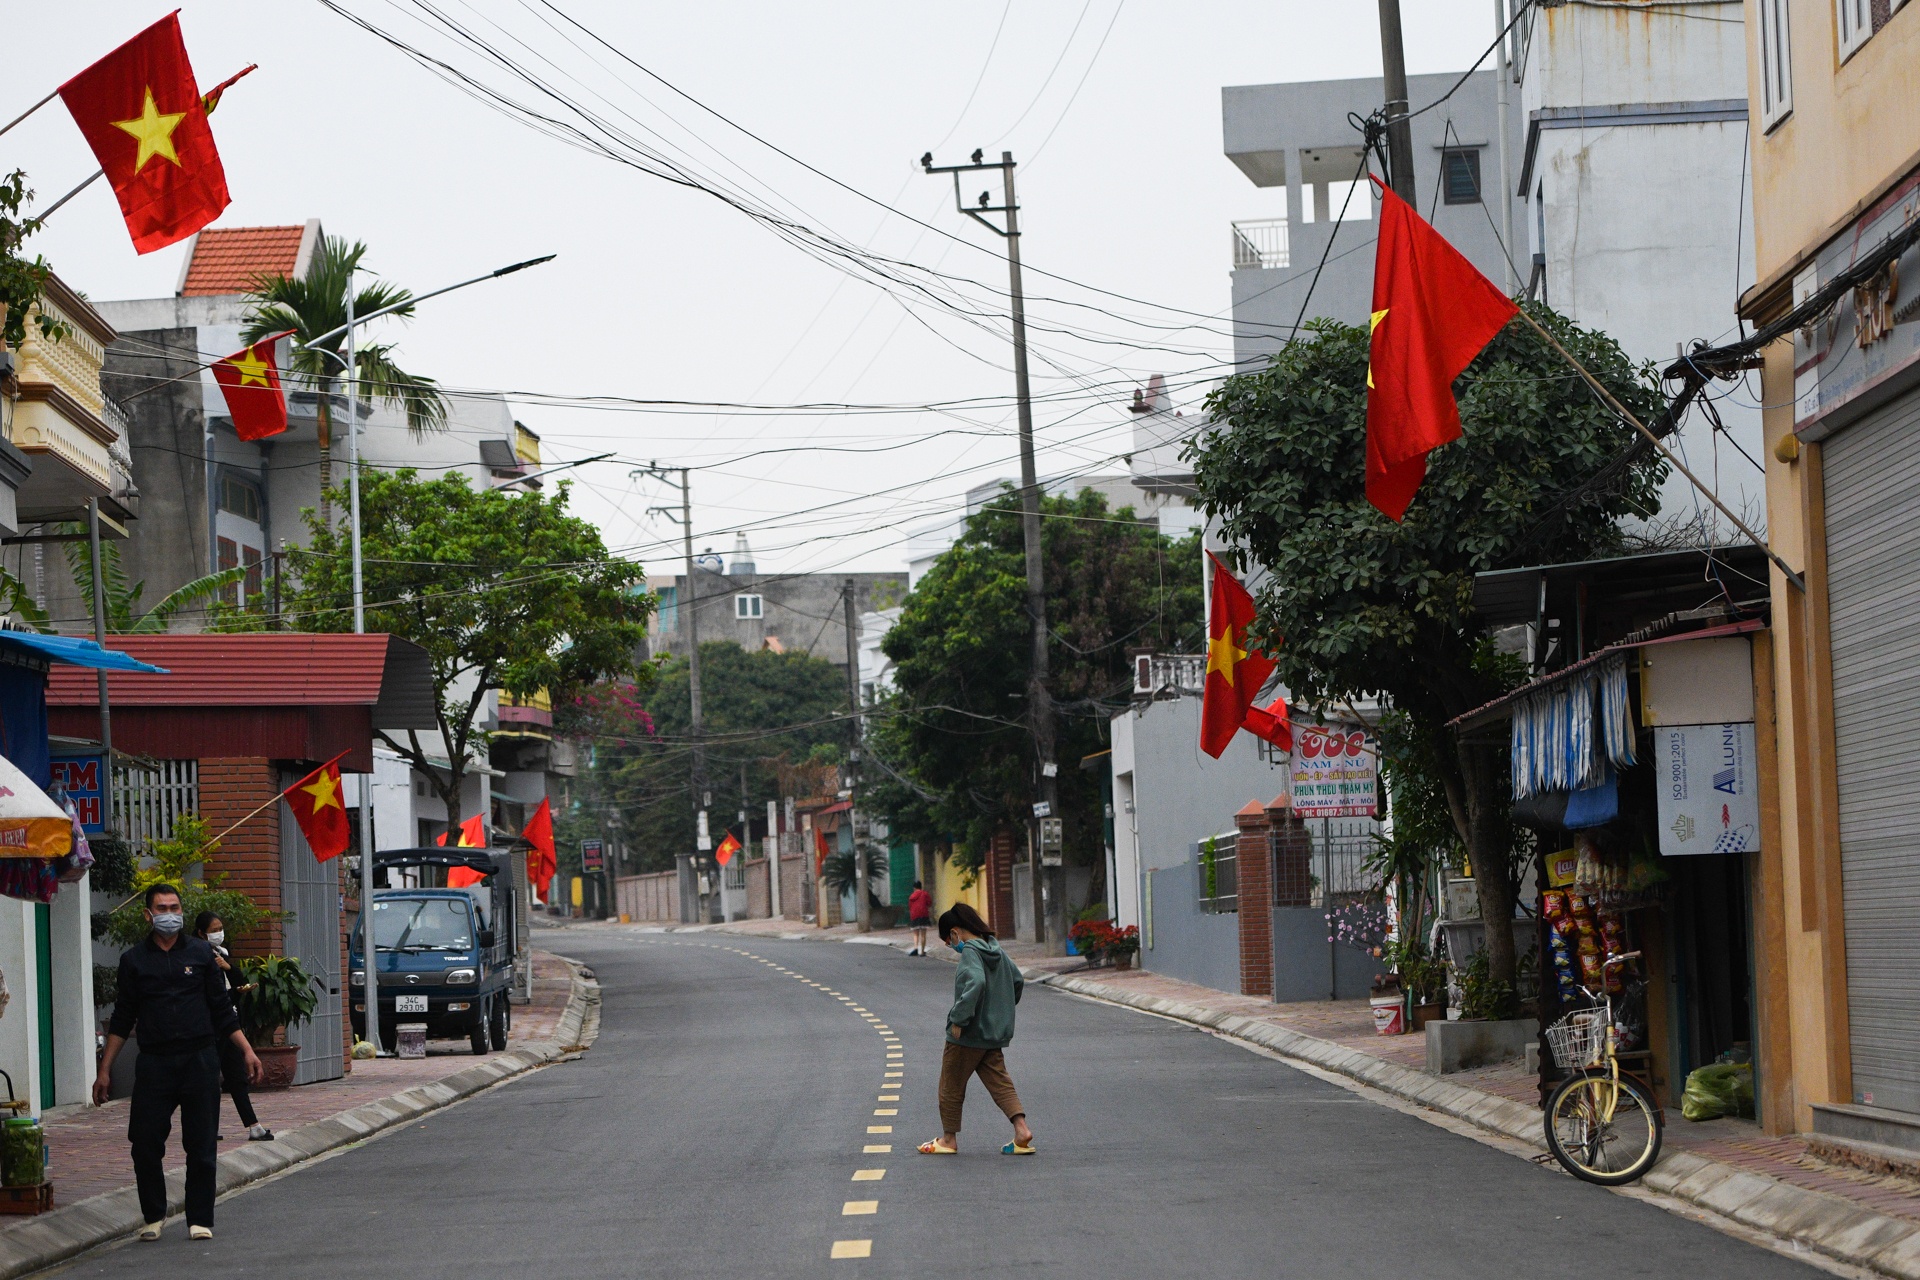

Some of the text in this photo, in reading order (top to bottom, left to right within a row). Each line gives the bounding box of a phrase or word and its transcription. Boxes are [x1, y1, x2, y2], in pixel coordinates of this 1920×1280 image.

[1300, 760, 1332, 769] NAM
[1670, 732, 1682, 801] ISO 9001:2015
[1301, 809, 1315, 817] Tel:
[4, 827, 26, 847] BEER
[399, 1004, 425, 1012] 293.05
